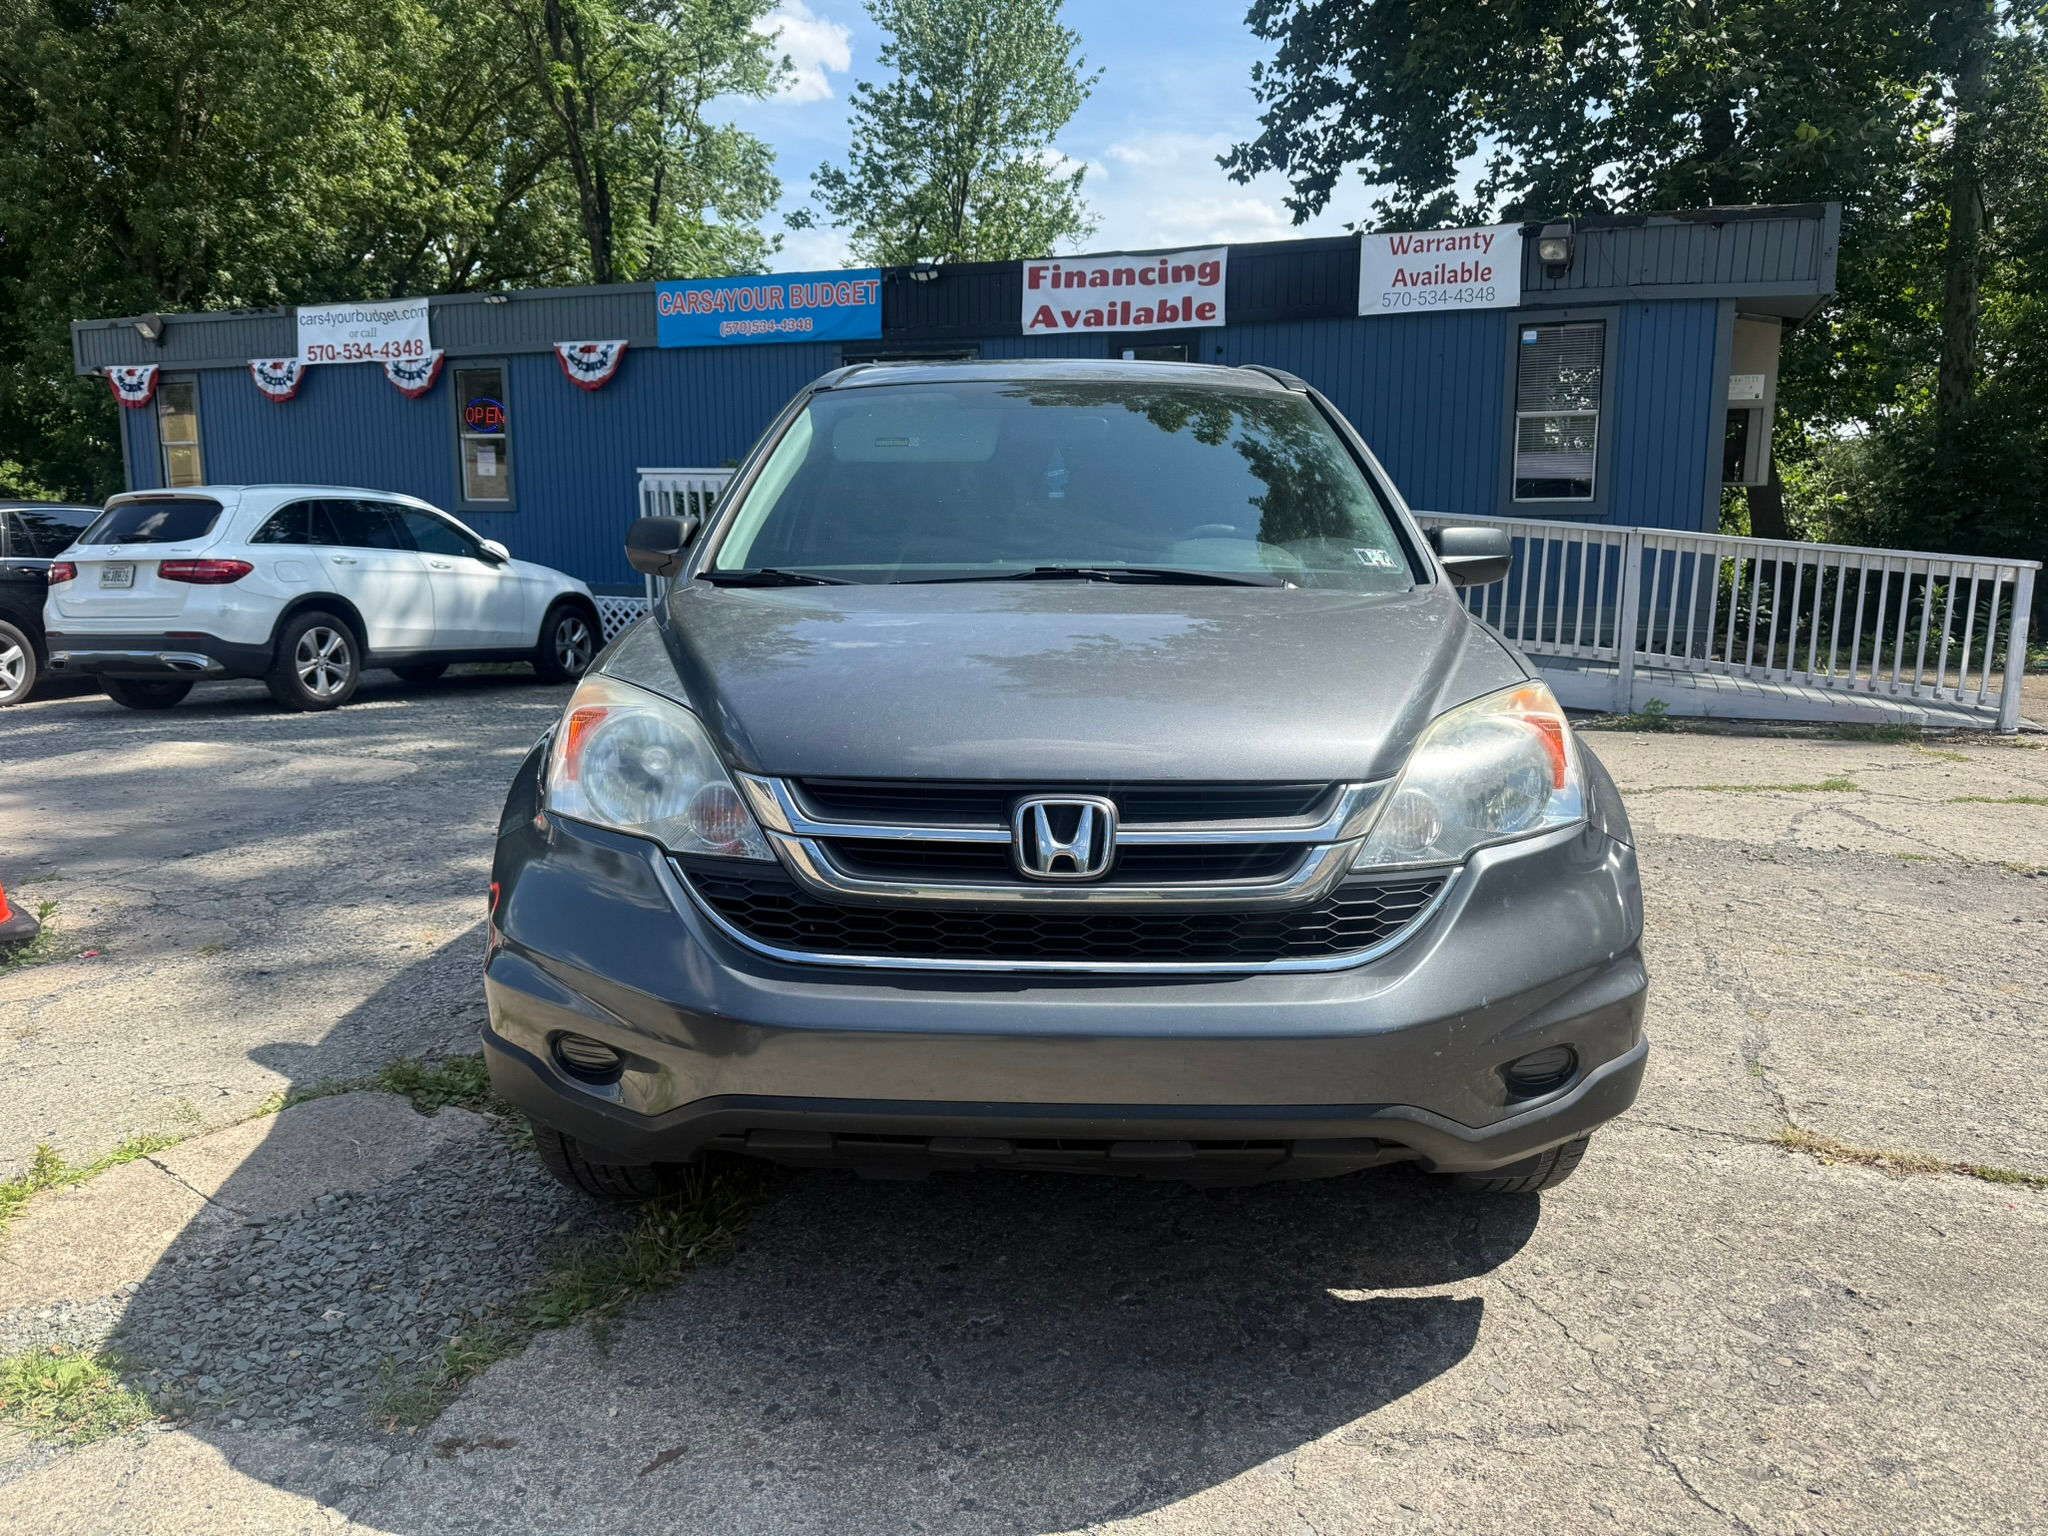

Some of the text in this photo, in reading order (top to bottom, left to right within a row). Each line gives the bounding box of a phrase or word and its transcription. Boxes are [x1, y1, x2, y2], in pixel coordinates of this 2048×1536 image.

[1389, 232, 1495, 255] Warranty
[1028, 258, 1221, 290] Financing
[1391, 260, 1492, 287] Available
[658, 279, 880, 316] CARS4YOUR BUDGET
[1382, 286, 1495, 307] 570-534-4348
[299, 307, 428, 328] cars4yourbudget.com
[1029, 296, 1217, 329] Available
[348, 327, 377, 339] or call
[719, 317, 814, 338] (570)534-4348
[307, 339, 424, 362] 570-534-4348
[465, 406, 506, 425] OPEN
